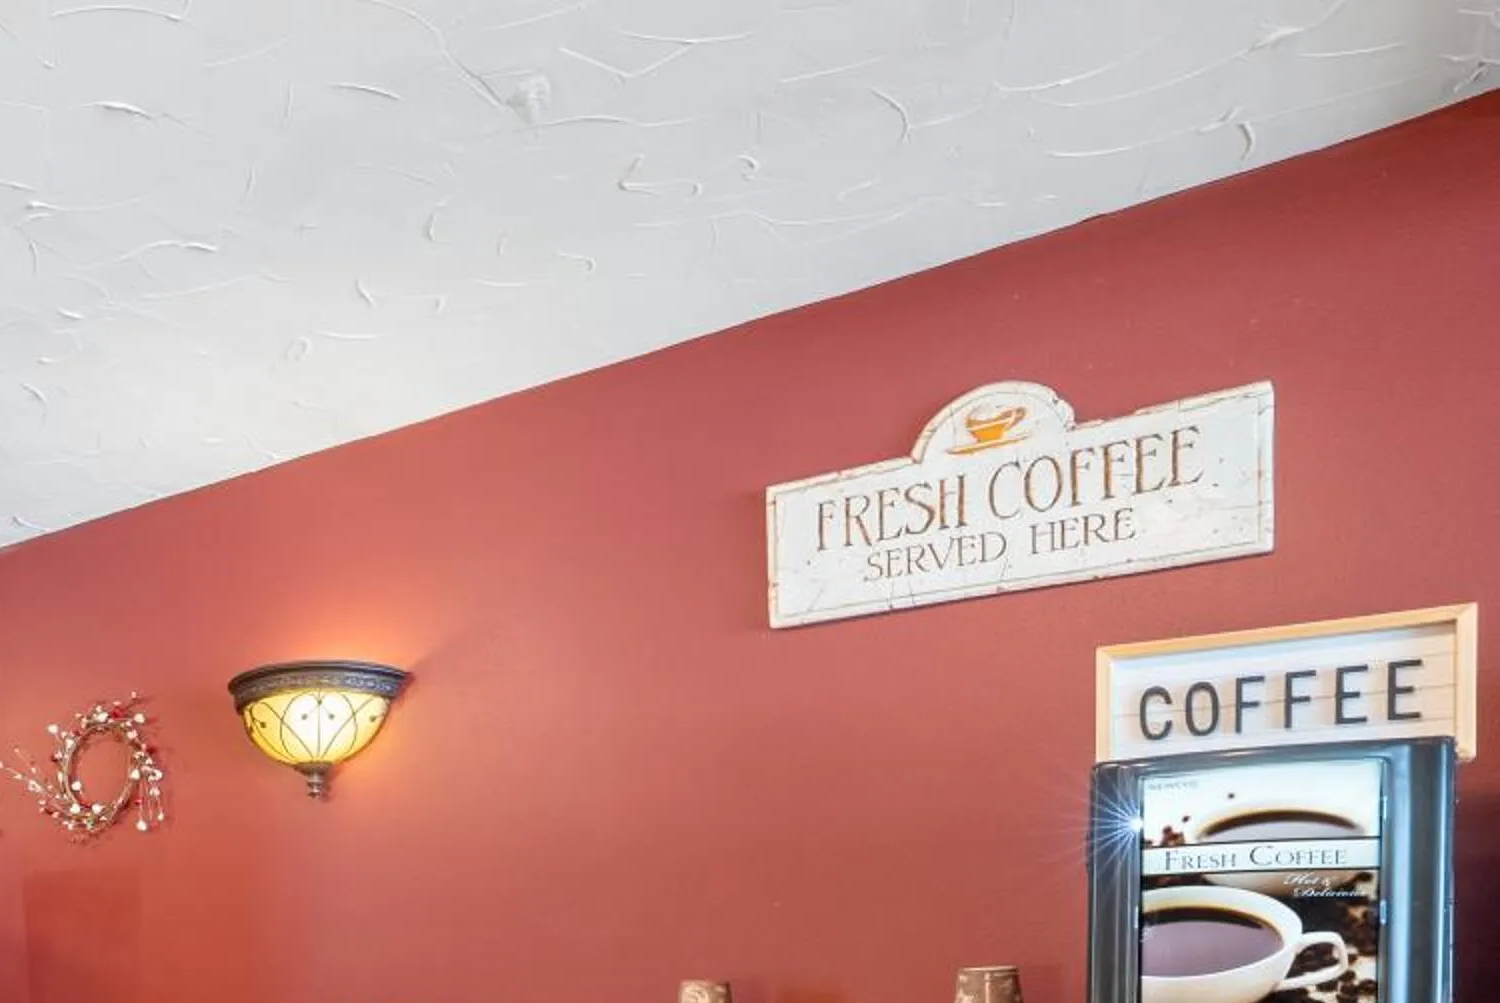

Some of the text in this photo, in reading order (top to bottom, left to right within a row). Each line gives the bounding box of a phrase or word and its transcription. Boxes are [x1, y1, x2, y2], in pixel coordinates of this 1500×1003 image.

[815, 425, 1205, 552] FRESH COFFEE
[863, 507, 1137, 582] SERVED HERE
[1138, 659, 1425, 742] COFFEE
